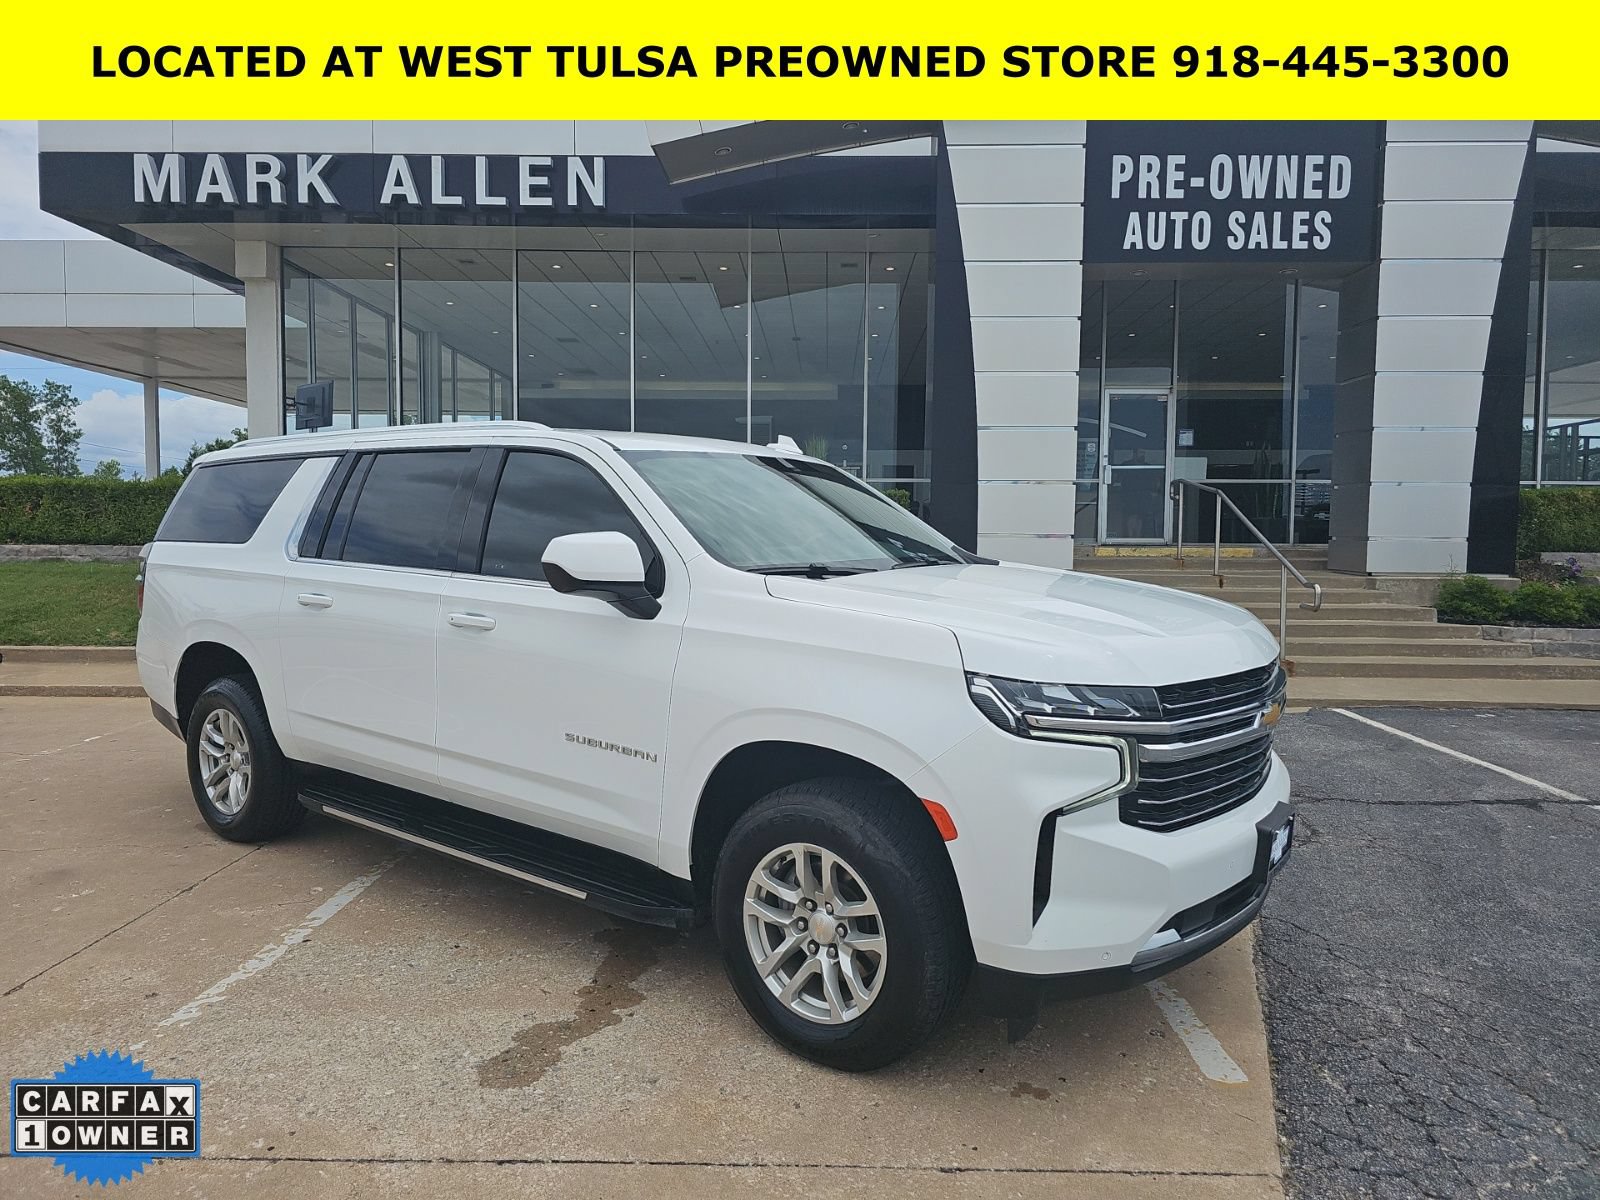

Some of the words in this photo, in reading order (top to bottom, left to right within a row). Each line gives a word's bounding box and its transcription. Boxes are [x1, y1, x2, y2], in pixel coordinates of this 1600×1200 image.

[132, 153, 340, 206] MARK
[379, 154, 606, 208] ALLEN
[1110, 153, 1353, 200] PRE-OWNED
[1122, 210, 1212, 251] AUTO
[1227, 210, 1333, 251] SALES
[564, 732, 658, 763] SUBURBAN
